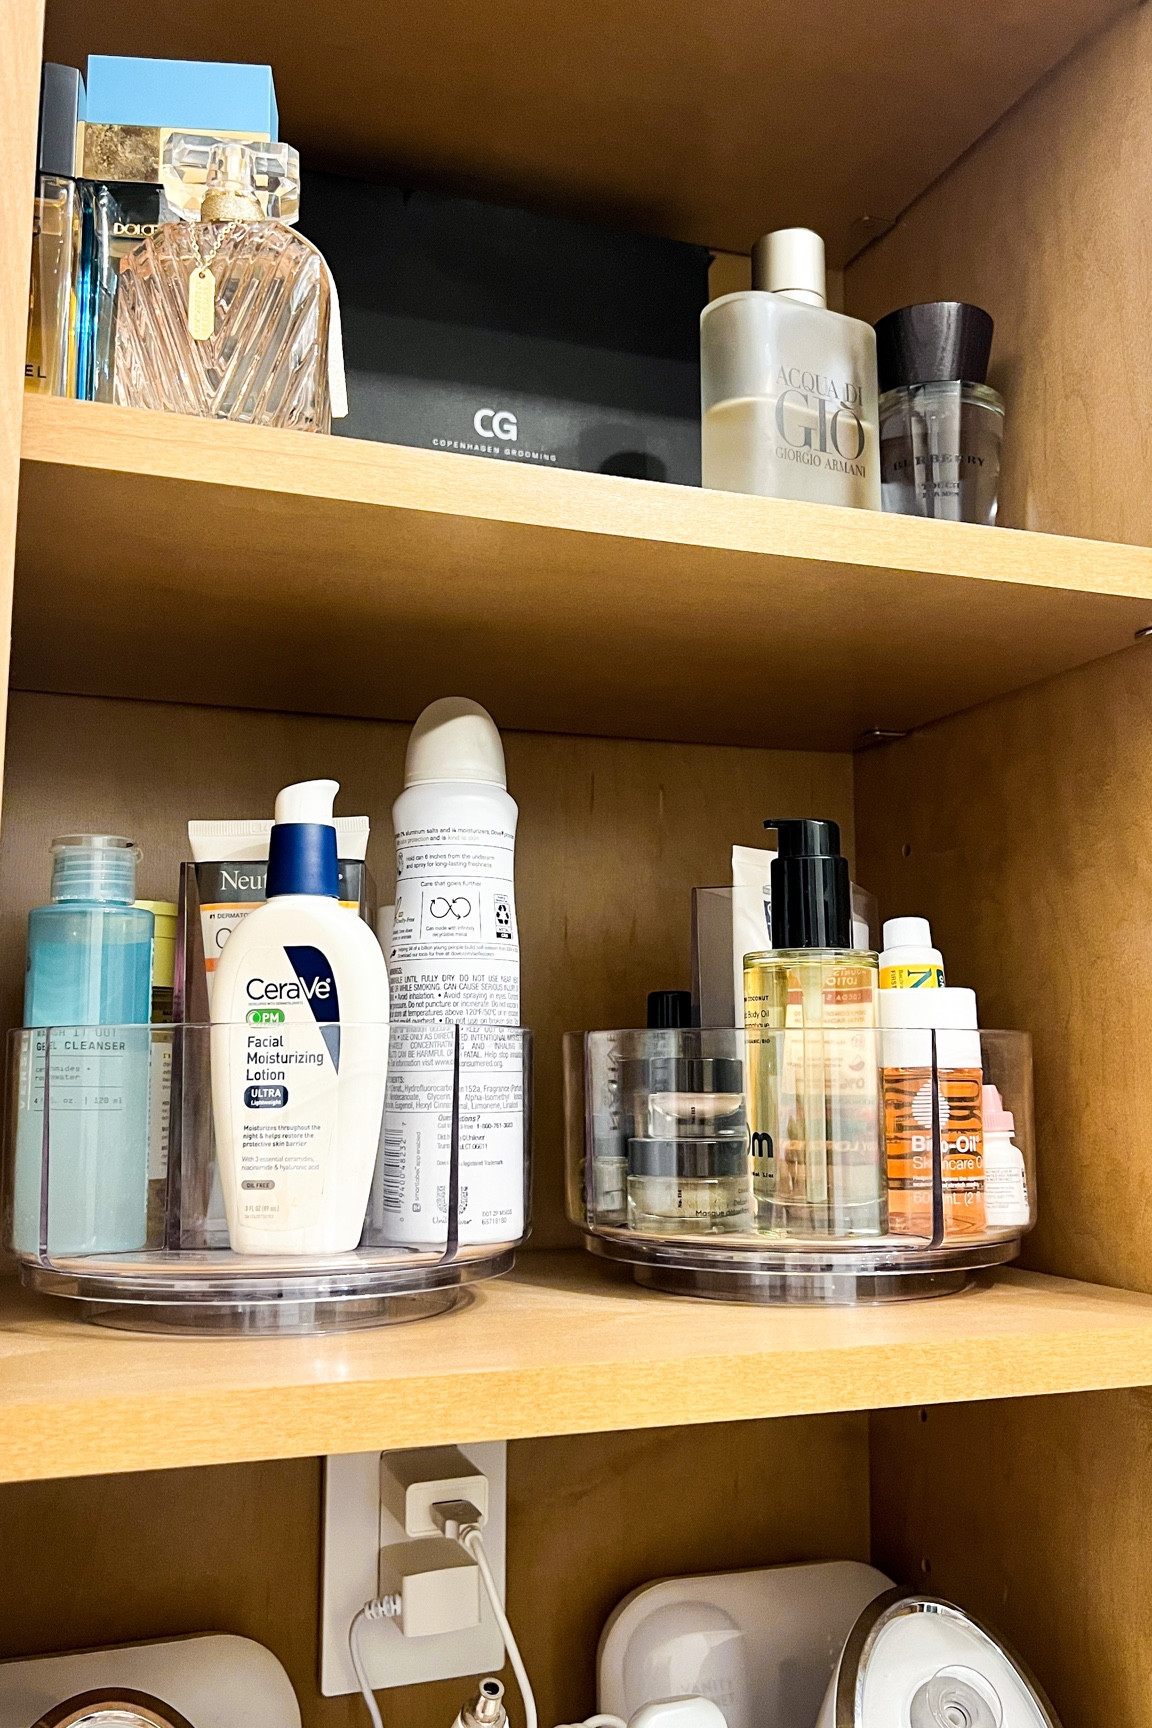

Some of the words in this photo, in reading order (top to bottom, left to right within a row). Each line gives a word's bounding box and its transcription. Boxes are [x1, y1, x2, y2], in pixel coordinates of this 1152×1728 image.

[25, 364, 47, 379] EL
[776, 364, 840, 400] ACQUA
[844, 382, 863, 407] DI
[473, 407, 518, 441] CG
[432, 438, 500, 454] COPENHAGEN
[504, 448, 557, 462] GROOMING
[775, 446, 822, 468] GIORGIO
[824, 457, 866, 479] ARMANI
[220, 870, 267, 891] Neut
[217, 912, 250, 920] DERMATO
[472, 974, 485, 982] NOT
[246, 976, 331, 1000] CeraVe
[444, 982, 456, 990] CAN
[458, 982, 480, 990] CAUSE
[425, 1000, 452, 1009] puncture
[262, 1012, 280, 1023] PM
[408, 1009, 444, 1018] temperatures
[760, 1010, 770, 1018] Oil
[64, 1041, 126, 1051] CLEANSER
[247, 1035, 284, 1048] Facial
[247, 1051, 324, 1066] Moisturizing
[484, 1050, 498, 1059] Help
[246, 1068, 285, 1081] Lotion
[250, 1088, 282, 1098] ULTRA
[244, 1124, 277, 1132] Moisturizes
[278, 1124, 311, 1132] throughout
[264, 1132, 281, 1140] helps
[242, 1140, 272, 1148] protective
[912, 1156, 974, 1171] Skncare
[696, 1210, 724, 1218] Masque
